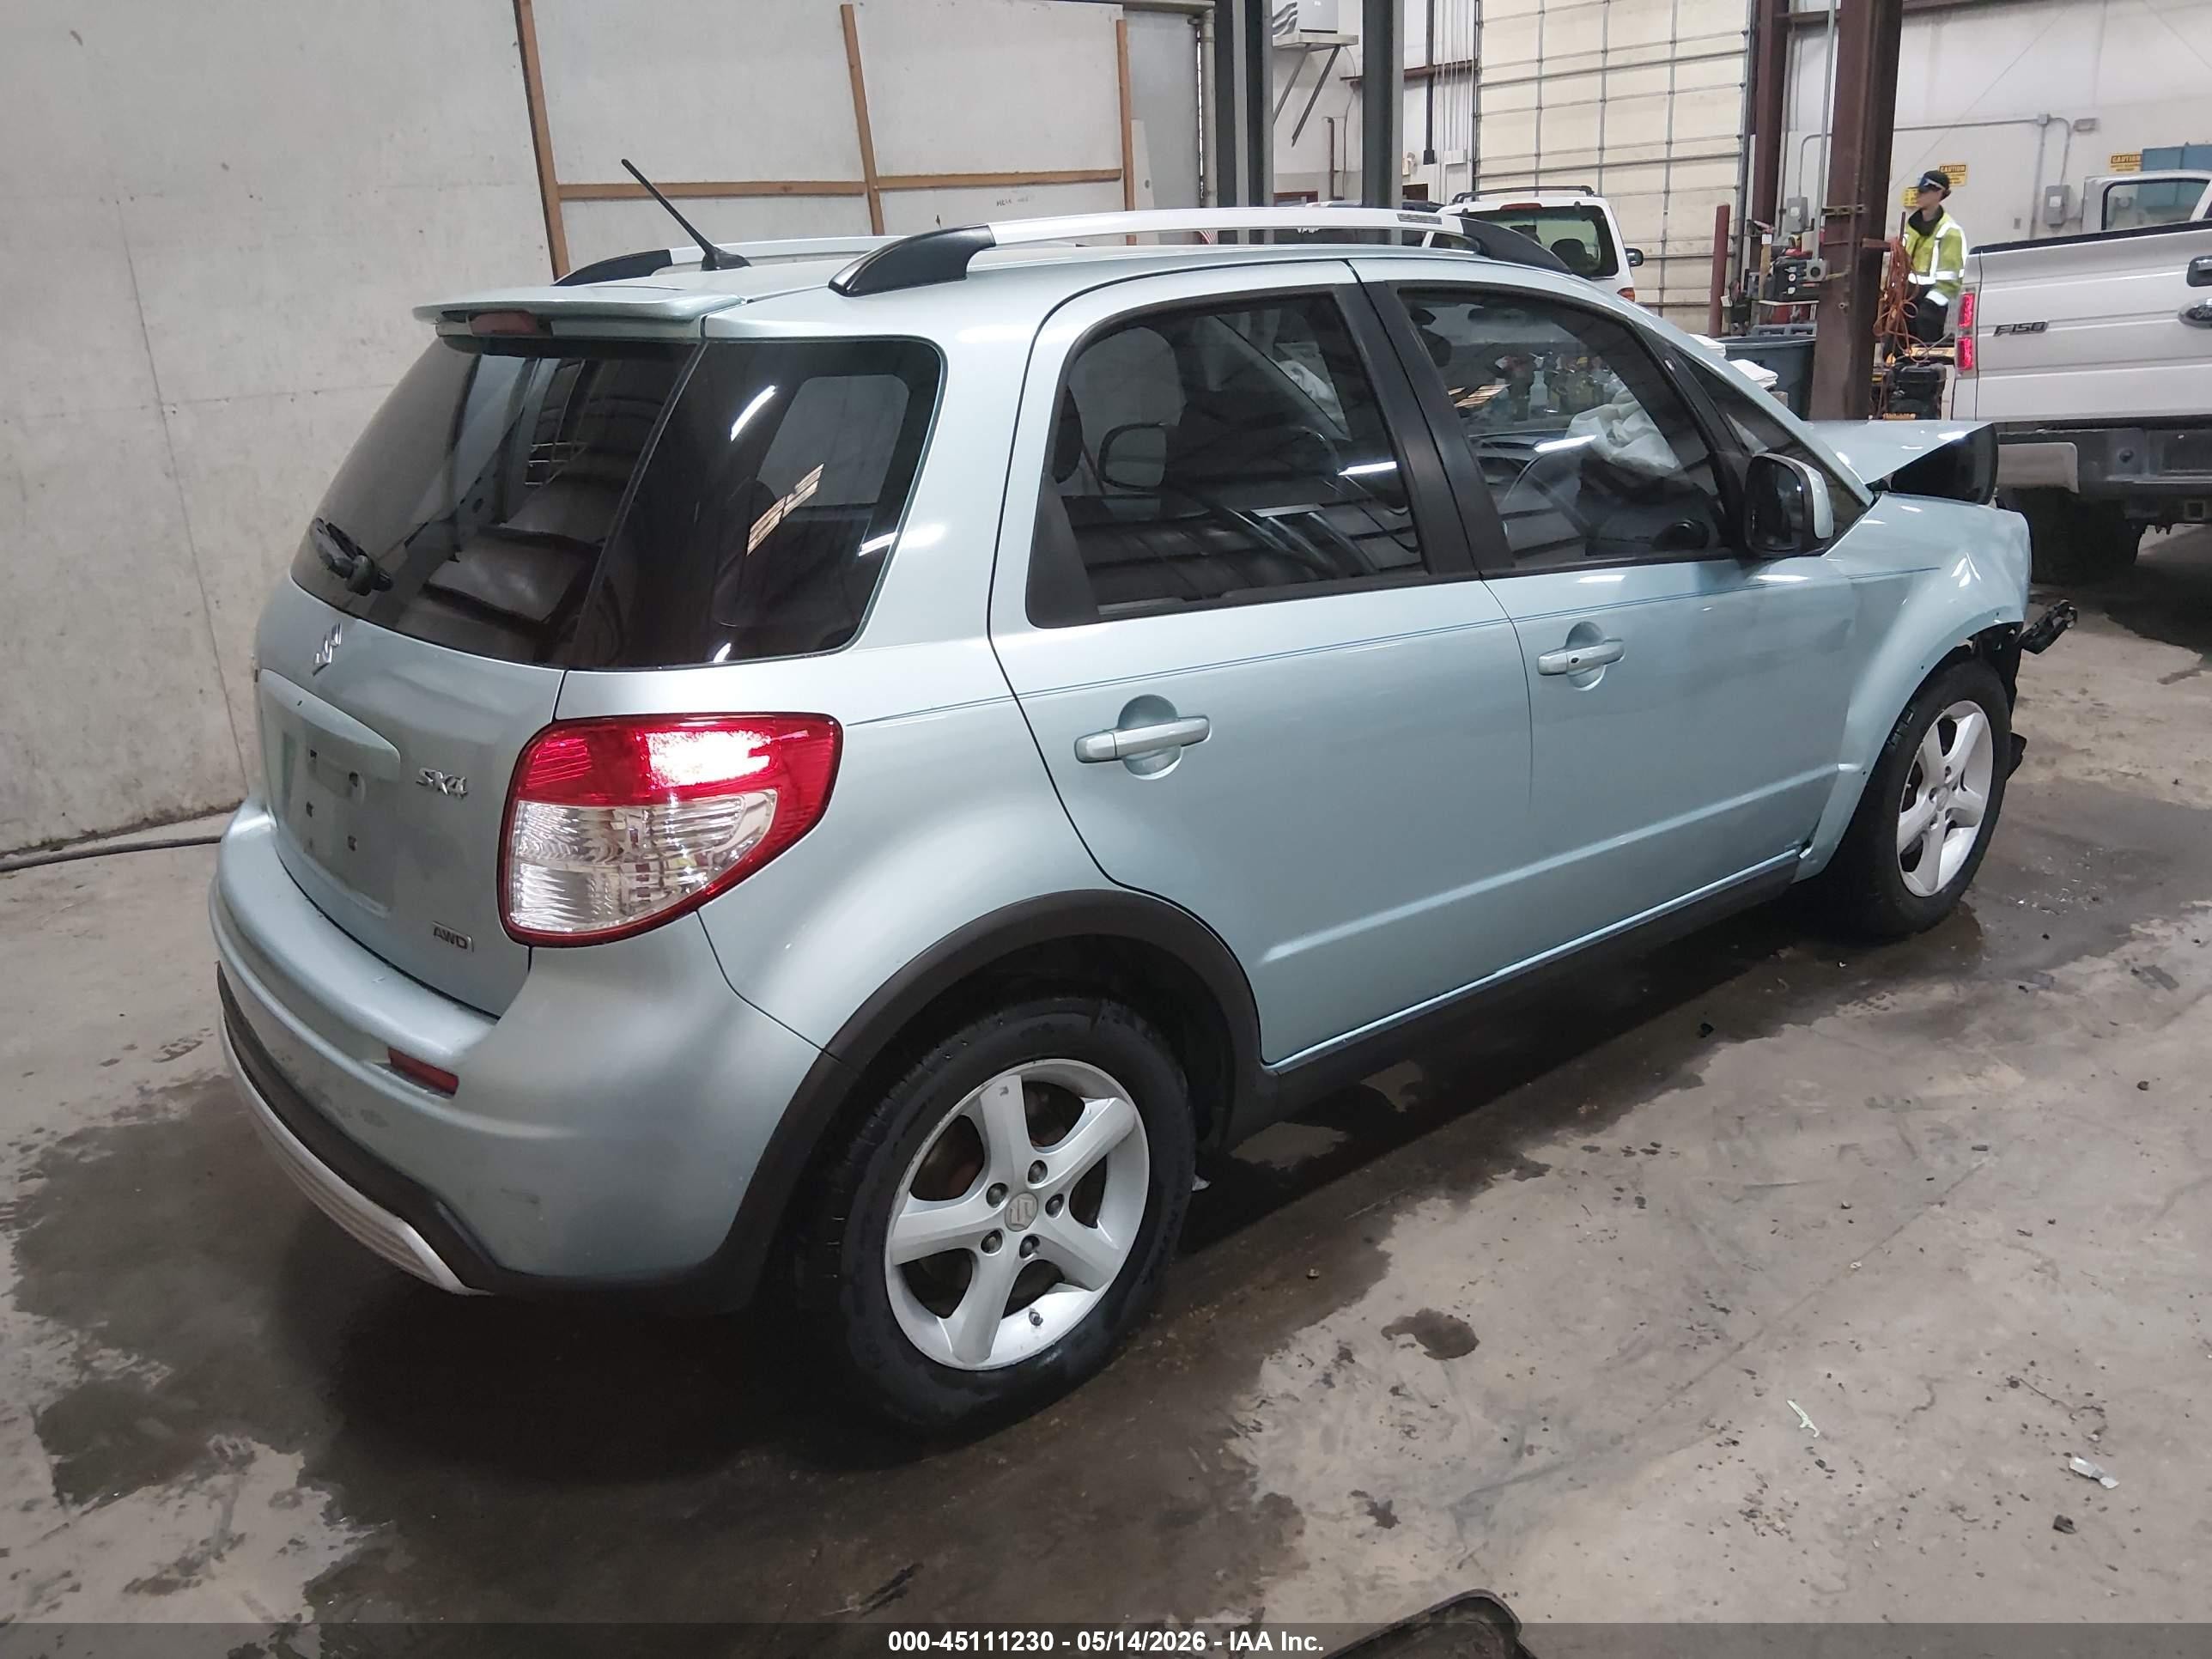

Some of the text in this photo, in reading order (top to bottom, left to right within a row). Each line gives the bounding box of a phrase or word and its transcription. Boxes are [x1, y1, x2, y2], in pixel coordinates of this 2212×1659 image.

[2112, 155, 2142, 163] CAUTION
[416, 768, 468, 798] SX4
[433, 926, 468, 950] AWD
